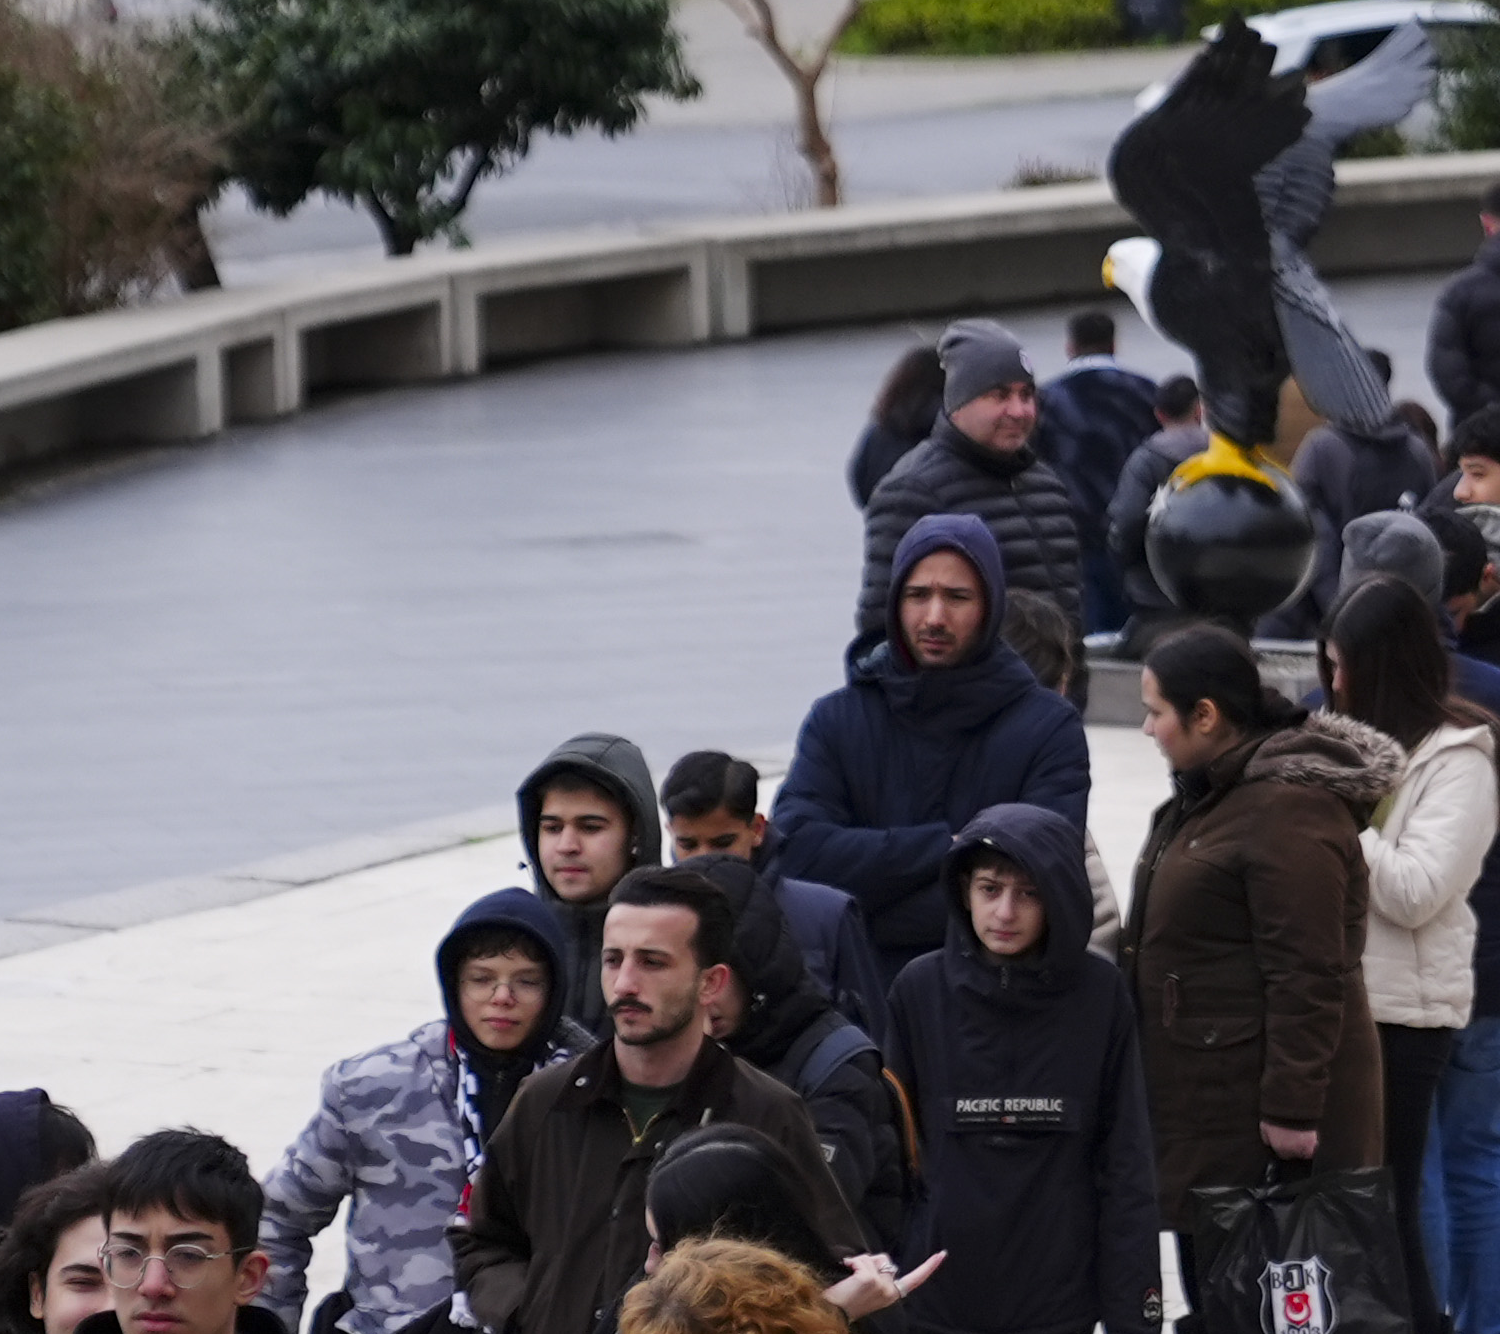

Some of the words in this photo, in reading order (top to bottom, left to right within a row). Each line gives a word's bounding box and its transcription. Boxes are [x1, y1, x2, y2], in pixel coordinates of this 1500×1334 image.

[956, 1098, 1001, 1113] PACIFIC
[1003, 1098, 1064, 1113] REPUBLIC
[1271, 1268, 1316, 1289] BJK
